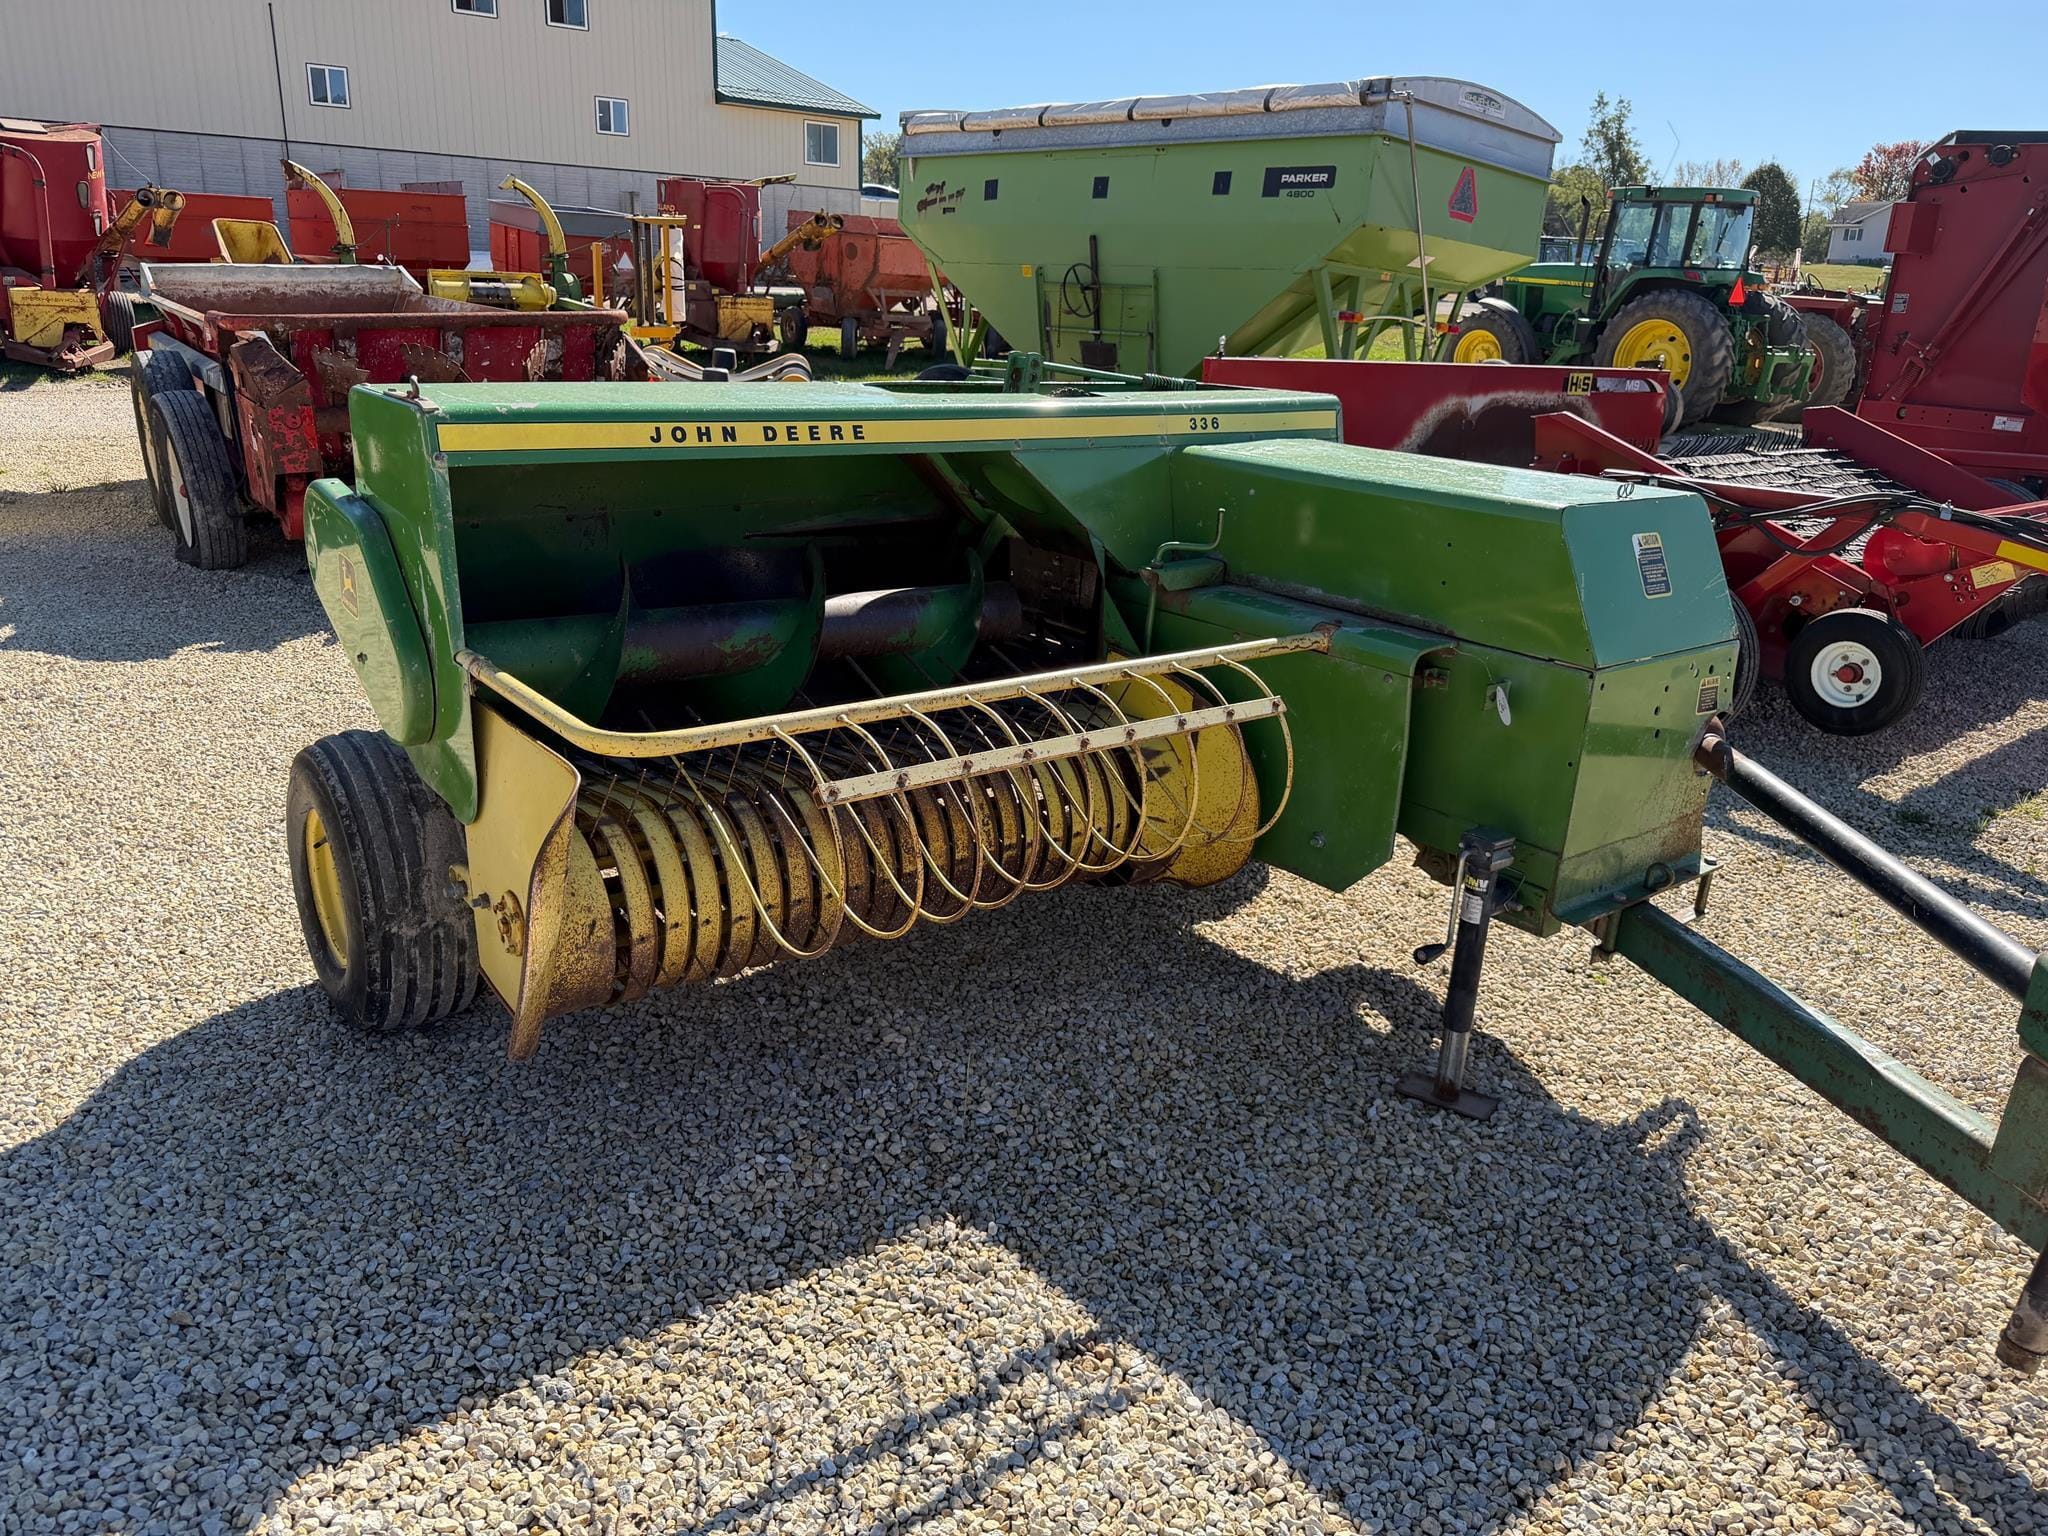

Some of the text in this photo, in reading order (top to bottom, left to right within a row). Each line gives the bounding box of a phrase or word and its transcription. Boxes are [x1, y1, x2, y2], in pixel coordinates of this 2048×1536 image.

[1281, 173, 1329, 183] PARKER
[1286, 190, 1315, 198] 4800
[1625, 380, 1640, 391] M9
[649, 417, 1219, 443] JOHN DEERE 336
